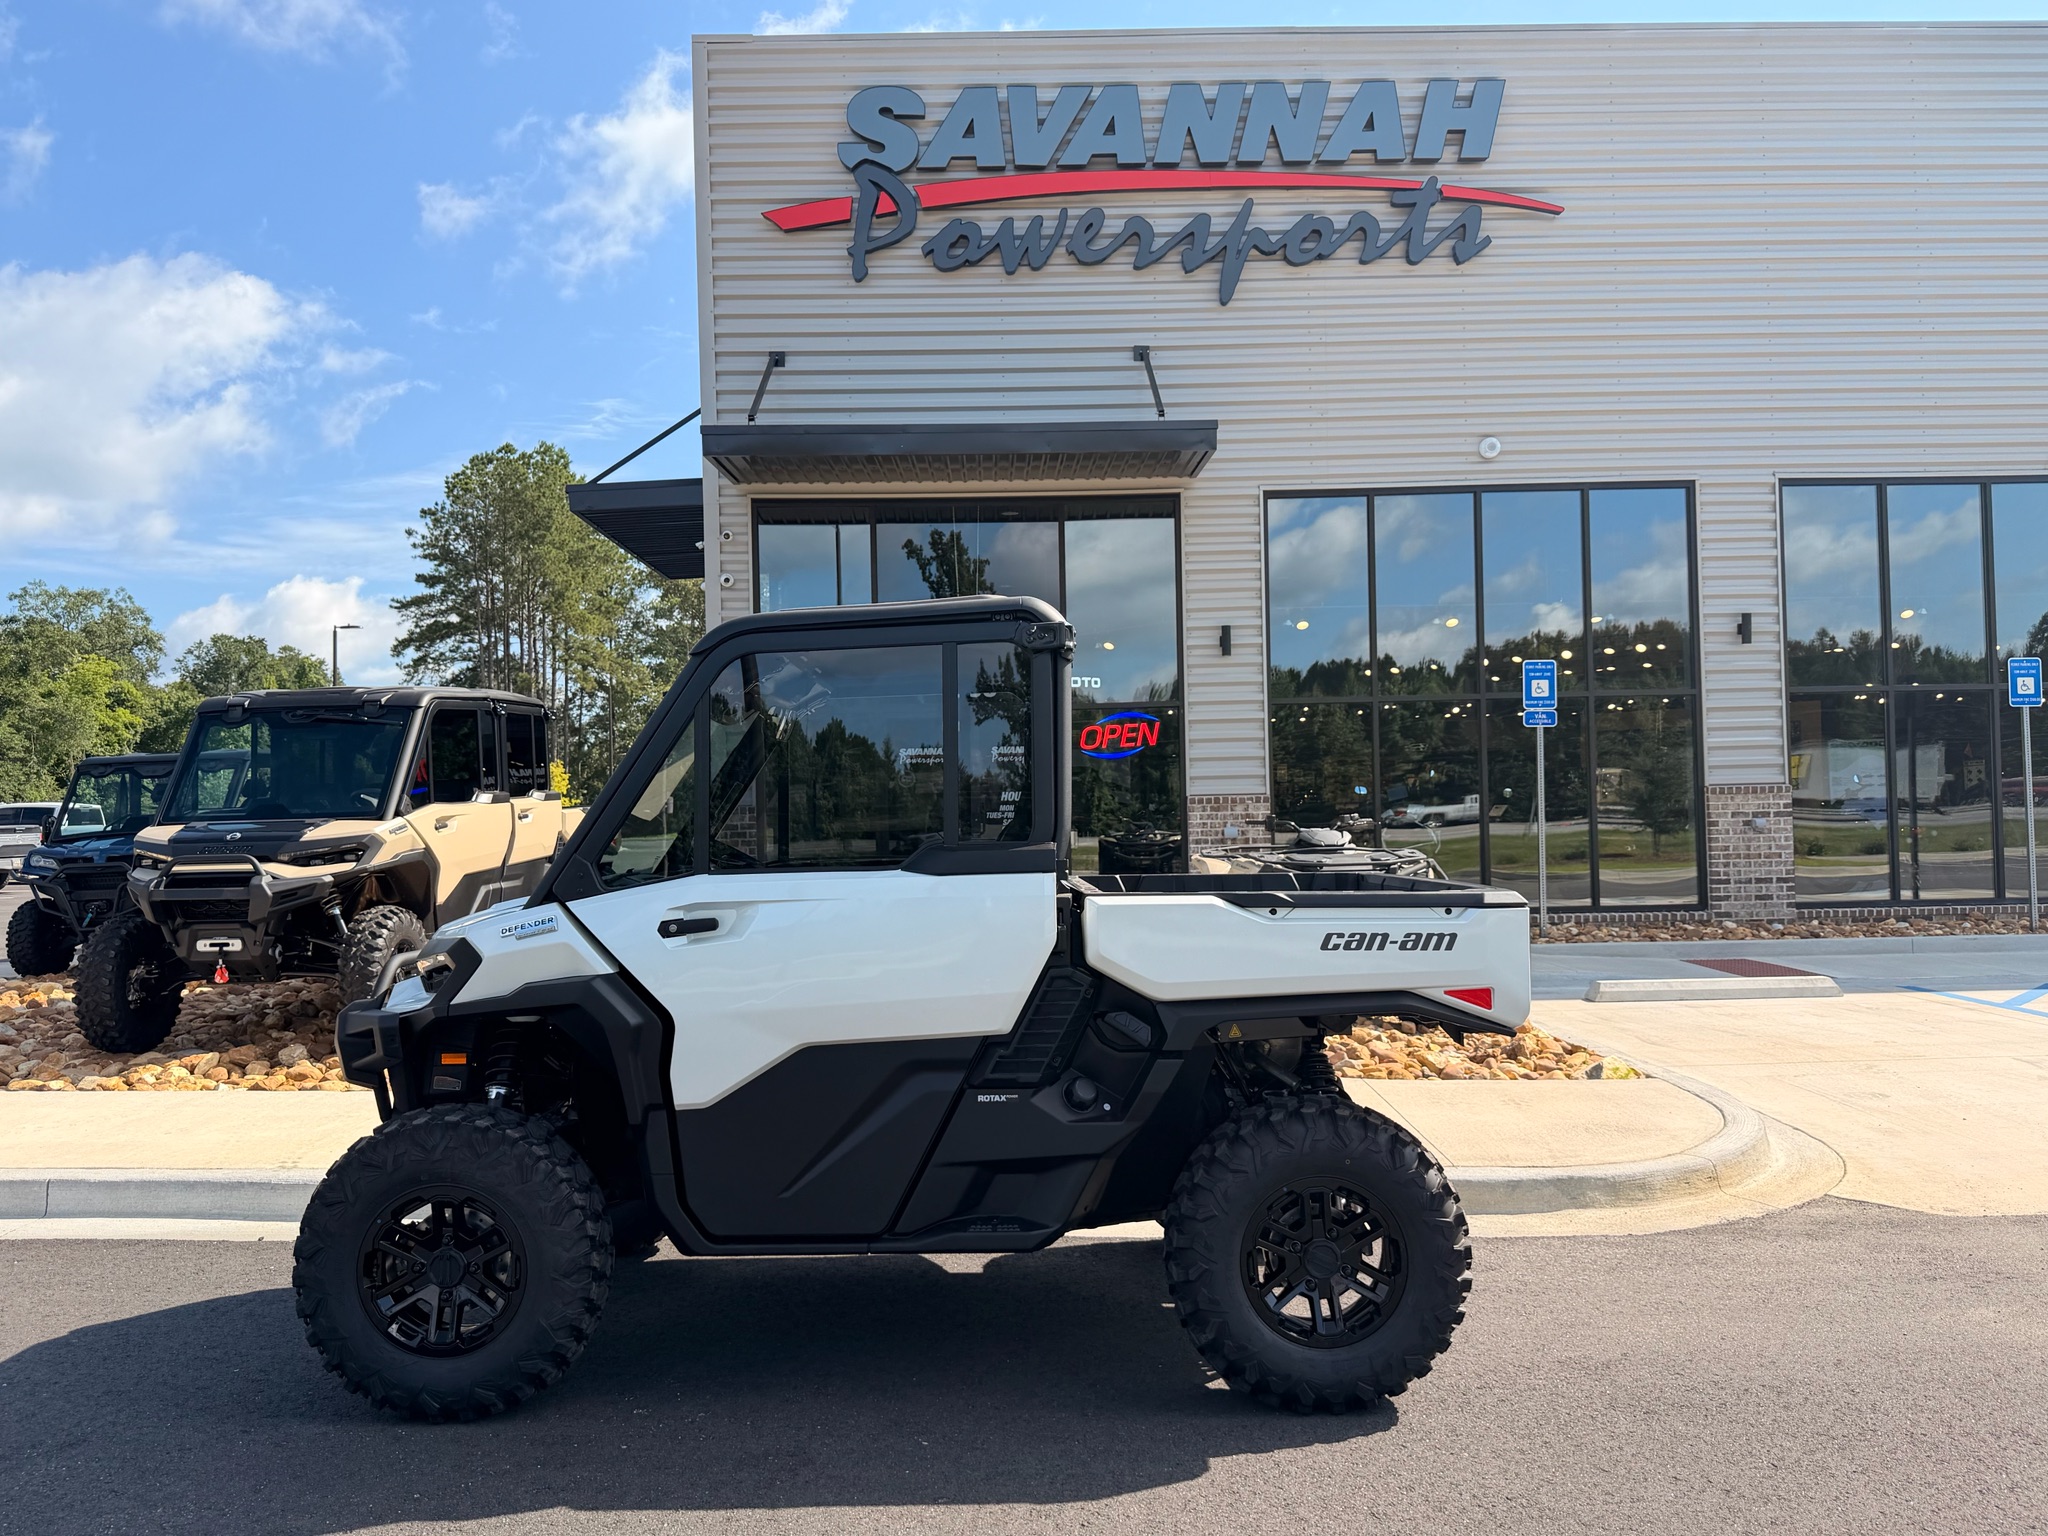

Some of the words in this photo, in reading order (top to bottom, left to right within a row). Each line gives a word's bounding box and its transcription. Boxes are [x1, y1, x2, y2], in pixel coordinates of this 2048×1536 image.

[837, 79, 1506, 173] SAVANNAH
[847, 158, 1492, 307] Powersports
[1079, 721, 1161, 750] OPEN
[1000, 791, 1022, 802] HOU
[986, 811, 1015, 819] TUES-FRI
[501, 916, 554, 935] DEFENDER
[1319, 932, 1458, 951] can-am
[977, 1094, 1007, 1102] ROTAX
